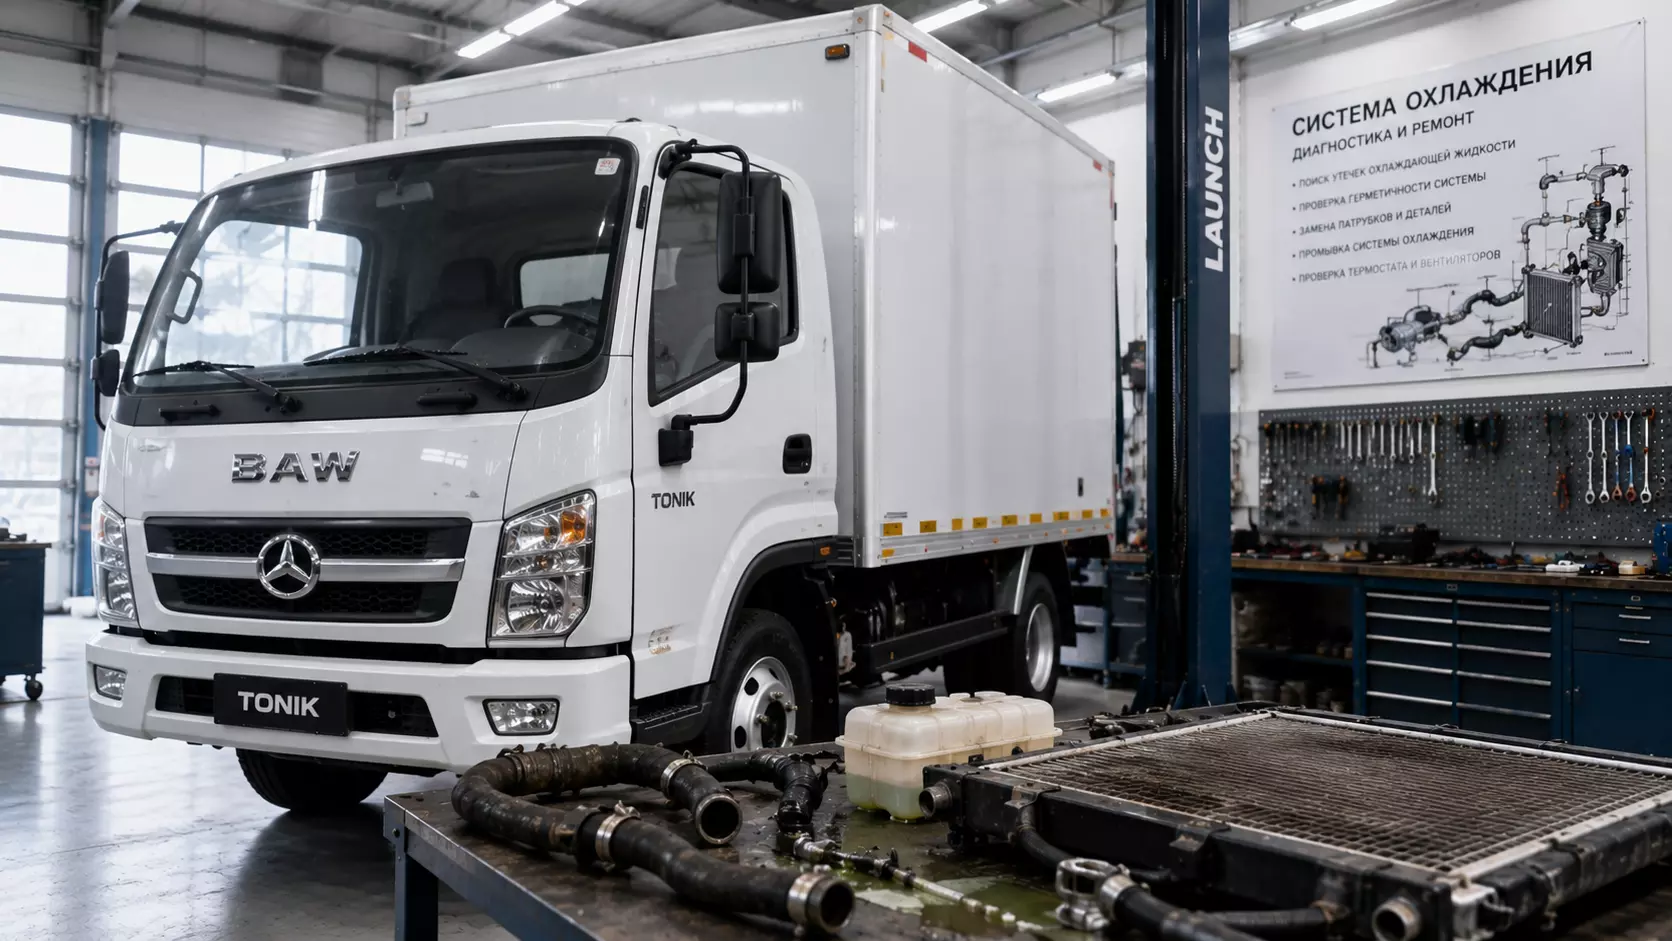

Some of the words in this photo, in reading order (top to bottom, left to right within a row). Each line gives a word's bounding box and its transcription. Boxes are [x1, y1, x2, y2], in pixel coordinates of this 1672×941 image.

[1292, 97, 1397, 136] СИСТЕМА
[1406, 50, 1593, 111] ОХЛАЖДЕНИЯ
[1292, 130, 1393, 162] ДИАГНОСТИКА
[1397, 125, 1408, 139] И
[1412, 110, 1475, 136] РЕМОНТ
[1299, 174, 1330, 188] ПОИСК
[1332, 167, 1366, 182] УТЕЧЕК
[1368, 149, 1451, 176] ОХЛАЖДАЮЩЕЙ
[1454, 139, 1517, 159] ЖИДКОСТИ
[1204, 105, 1224, 273] LAUNCH
[1299, 196, 1346, 212] ПРОВЕРКА
[1348, 181, 1432, 204] ГЕРМЕТИЧНОСТИ
[1434, 171, 1487, 189] СИСТЕМЫ
[1299, 221, 1336, 236] ЗАМЕНА
[1338, 212, 1393, 229] ПАТРУБКОВ
[1396, 211, 1403, 221] И
[1405, 201, 1452, 220] ДЕТАЛЕЙ
[1299, 243, 1350, 259] ПРОМЫВКА
[1353, 236, 1400, 252] СИСТЕМЫ
[1402, 226, 1475, 245] ОХЛАЖДЕНИЯ
[1299, 267, 1346, 283] ПРОВЕРКА
[1349, 261, 1408, 277] ТЕРМОСТАТА
[1410, 259, 1418, 269] И
[1420, 249, 1501, 268] ВЕНТИЛЯТОРОВ
[231, 450, 360, 483] BAW
[651, 490, 696, 510] TONIK
[237, 690, 320, 718] TONIK
